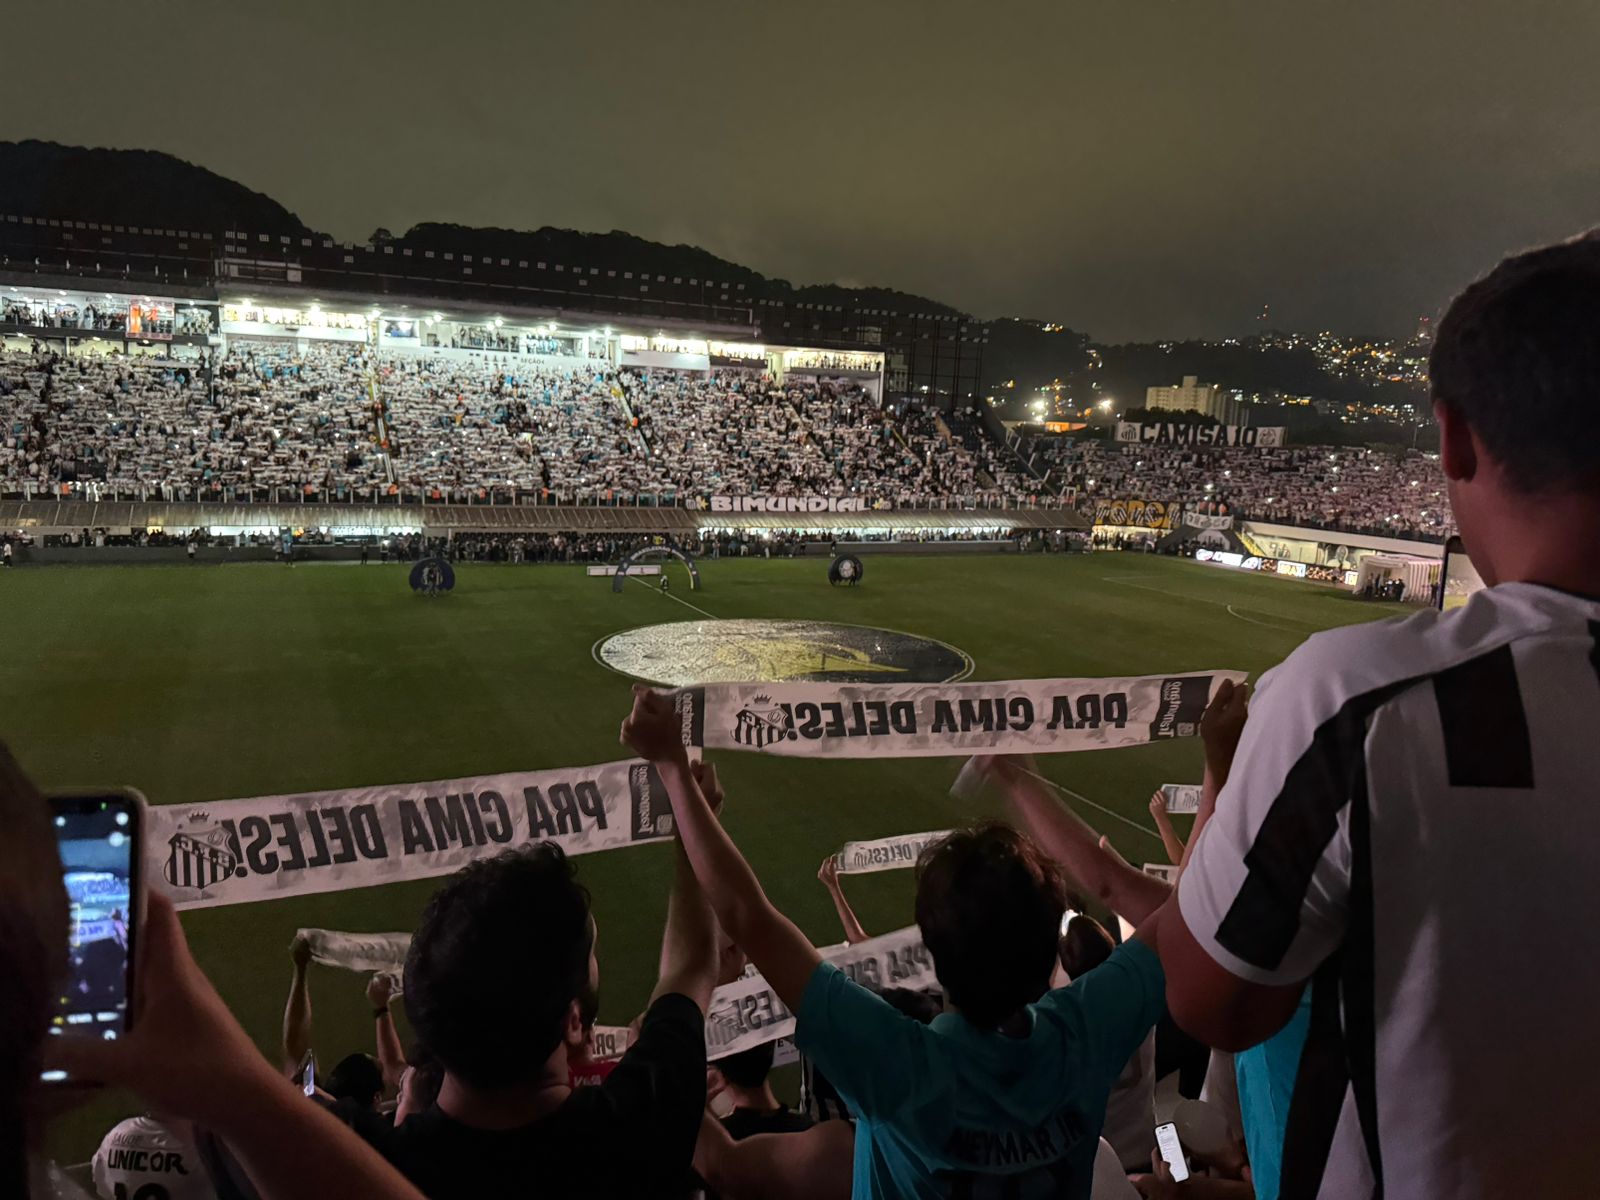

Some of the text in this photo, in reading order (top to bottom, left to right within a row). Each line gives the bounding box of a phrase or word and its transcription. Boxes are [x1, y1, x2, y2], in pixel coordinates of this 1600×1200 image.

[1139, 422, 1258, 447] CAMISA 10
[710, 495, 871, 512] BIMUNDIAL
[107, 1147, 189, 1176] UNICOR
